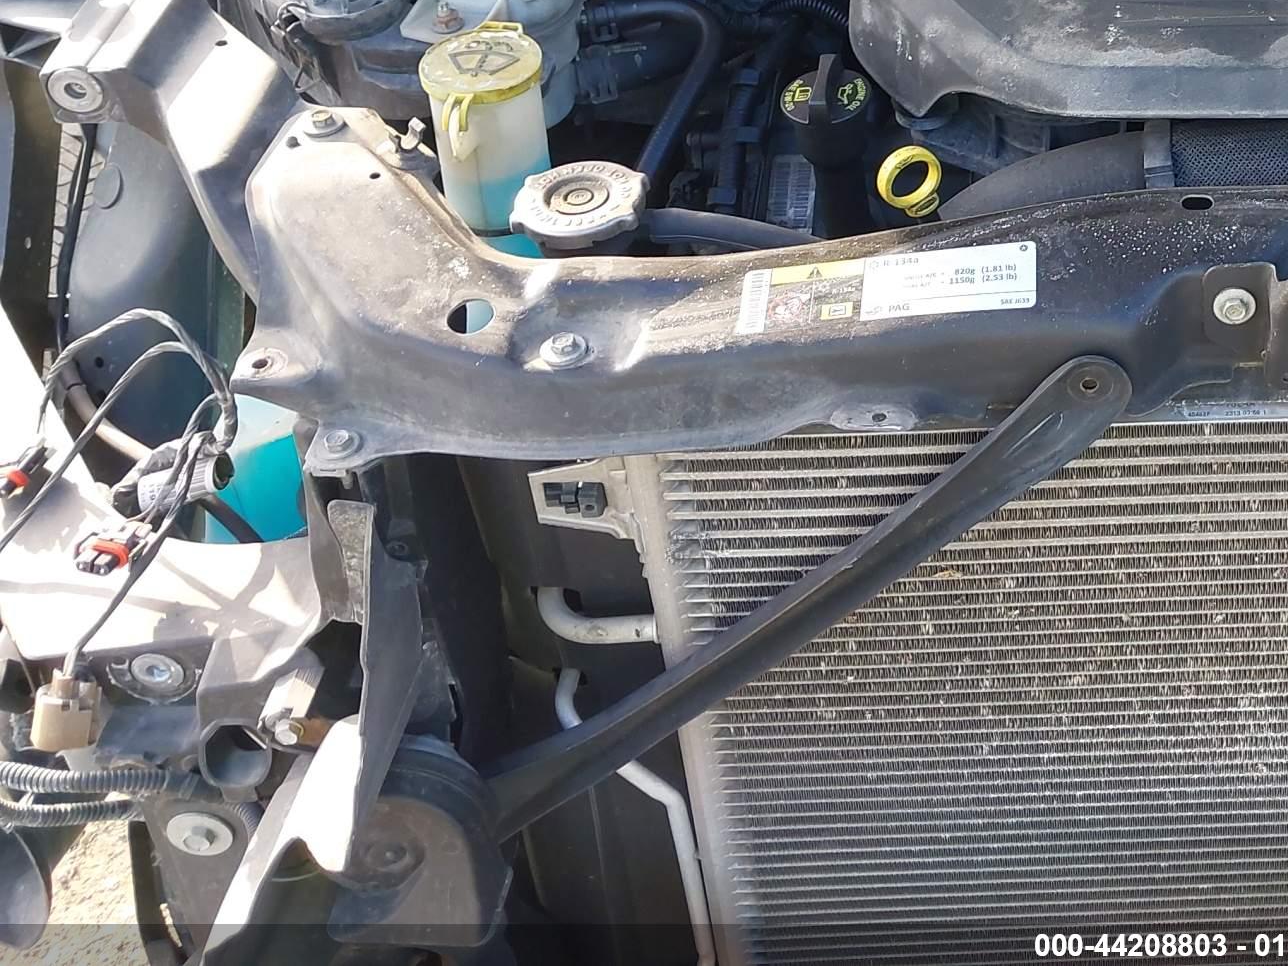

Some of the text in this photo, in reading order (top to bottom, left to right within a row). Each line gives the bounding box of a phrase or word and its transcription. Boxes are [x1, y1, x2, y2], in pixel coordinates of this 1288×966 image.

[844, 77, 867, 111] ENGINE OIL
[954, 267, 976, 277] 820g
[981, 265, 1004, 274] (1.81
[1005, 263, 1017, 272] lb)
[949, 276, 976, 285] 1150g
[982, 274, 1004, 283] (2.53
[1006, 273, 1018, 281] lb)
[888, 303, 911, 313] PAG
